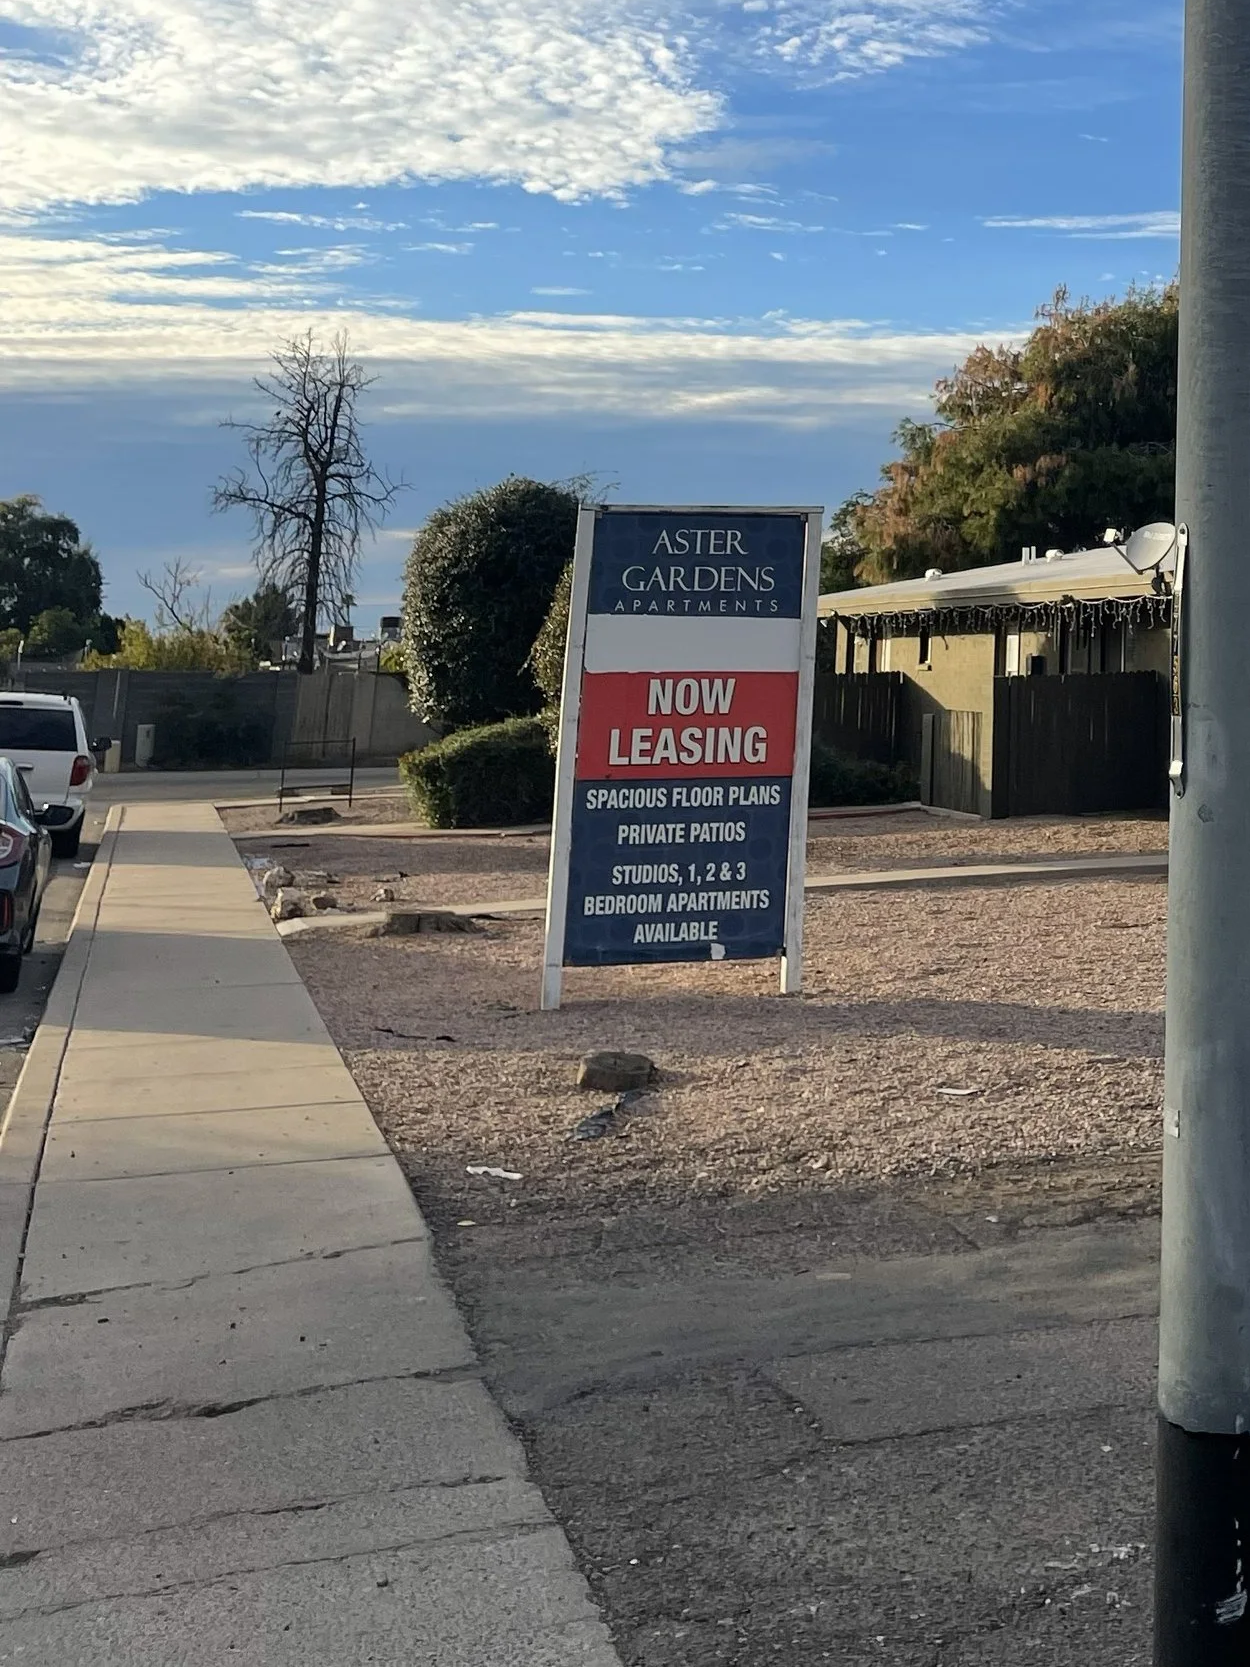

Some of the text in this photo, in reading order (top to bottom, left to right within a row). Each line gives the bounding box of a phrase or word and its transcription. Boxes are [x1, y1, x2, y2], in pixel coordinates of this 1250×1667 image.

[652, 529, 749, 555] ASTER
[621, 565, 775, 592] GARDENS
[614, 599, 778, 612] APARTMENTS
[647, 678, 736, 715] NOW
[609, 726, 768, 765] LEASING
[586, 785, 781, 809] SPACIOUS FLOOR PLANS
[617, 821, 746, 845] PRIVATE PATIOS
[612, 861, 746, 886] STUDIOS, 1, 2 & 3
[584, 889, 770, 916] BEDROOM APARTMENTS
[633, 921, 718, 944] AVAILABLE
